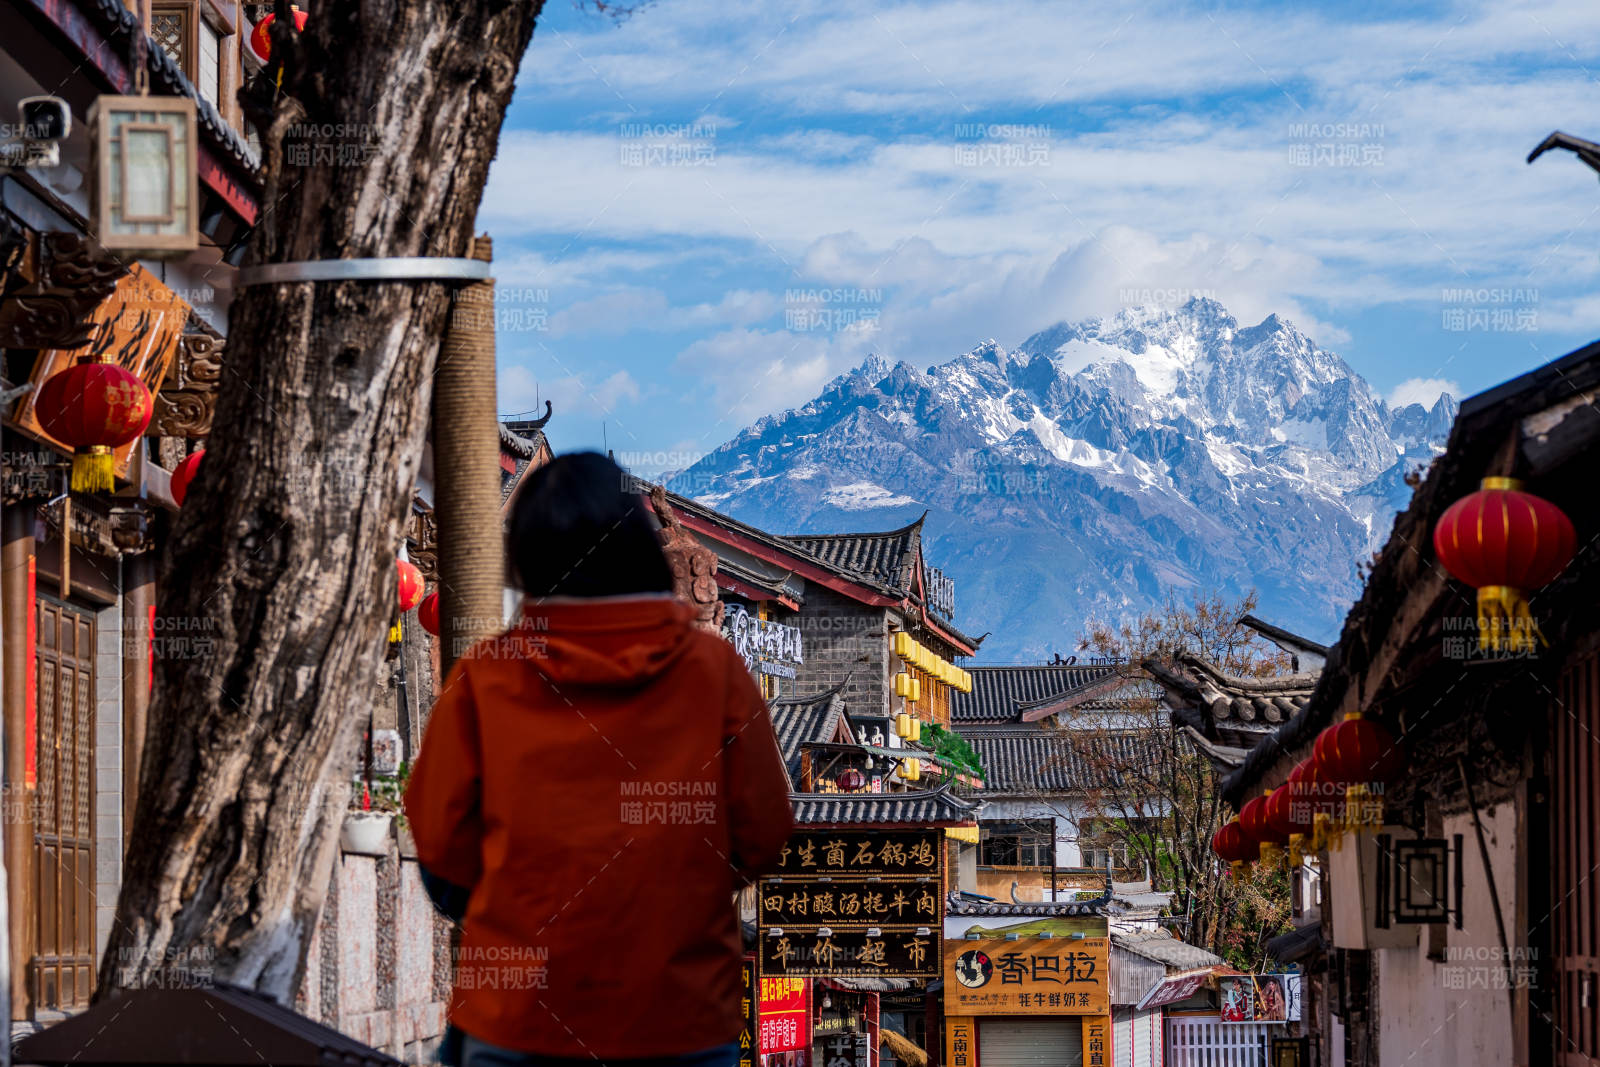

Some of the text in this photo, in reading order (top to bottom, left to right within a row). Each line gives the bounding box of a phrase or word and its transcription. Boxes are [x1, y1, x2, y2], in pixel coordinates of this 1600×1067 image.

[764, 889, 936, 917] 田村酸汤牦牛肉
[771, 936, 931, 969] 平价超市
[995, 951, 1099, 986] 香巴拉
[1018, 992, 1091, 1008] 牦牛鲜奶茶
[953, 1025, 968, 1066] 云南首
